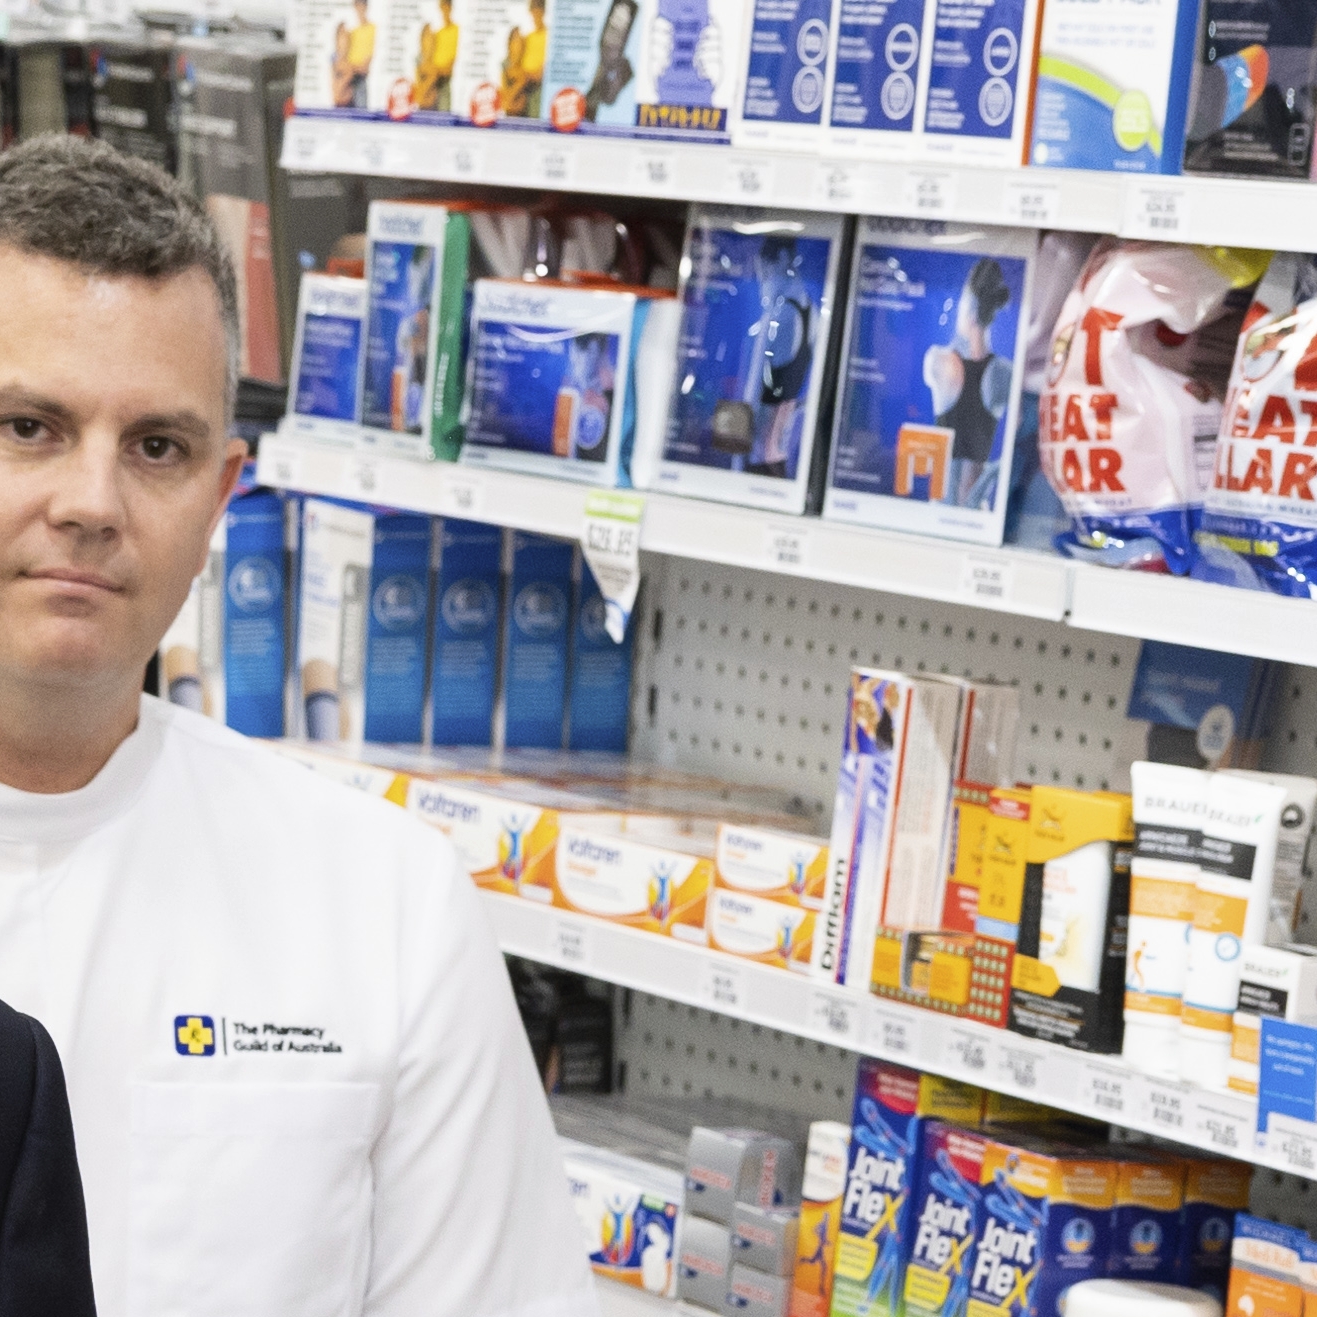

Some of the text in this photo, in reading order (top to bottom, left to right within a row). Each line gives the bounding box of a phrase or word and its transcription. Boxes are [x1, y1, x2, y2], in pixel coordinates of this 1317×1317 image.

[819, 856, 847, 972] Difflam
[232, 1021, 326, 1040] The Pharmacy
[233, 1039, 343, 1054] Guild of Australia
[848, 1146, 907, 1192] Joint
[918, 1193, 973, 1237] Joint
[976, 1216, 1037, 1264] Joint
